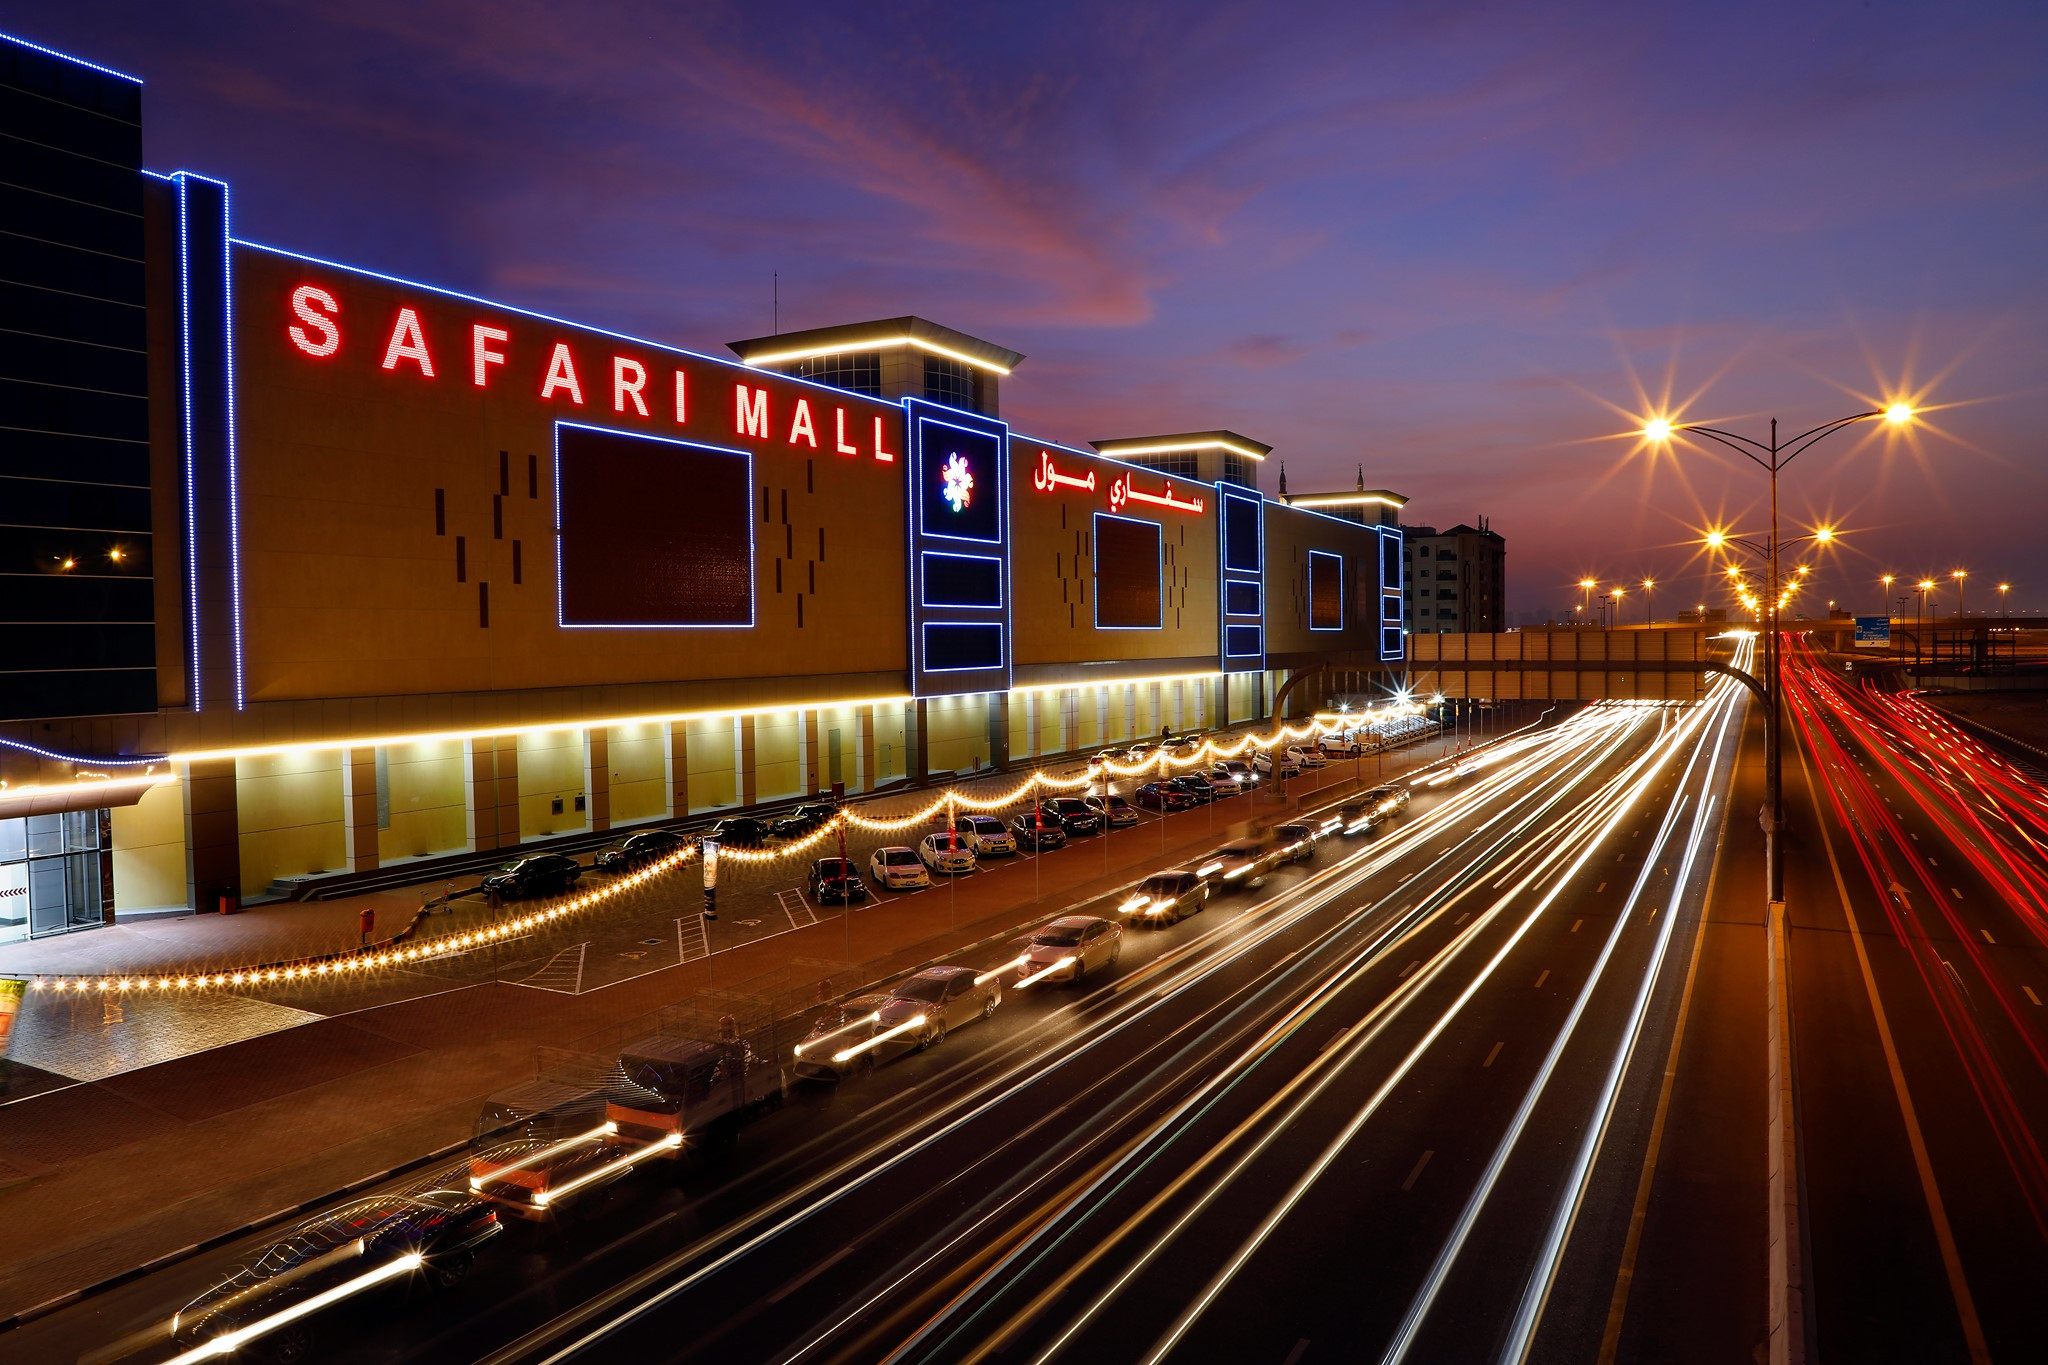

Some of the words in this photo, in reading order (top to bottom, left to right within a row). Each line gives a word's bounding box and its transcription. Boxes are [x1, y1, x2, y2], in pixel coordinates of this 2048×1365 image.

[289, 285, 686, 424] SAFARI
[736, 384, 894, 462] MALL
[1034, 450, 1096, 493] مول
[1110, 471, 1204, 513] سفاري
